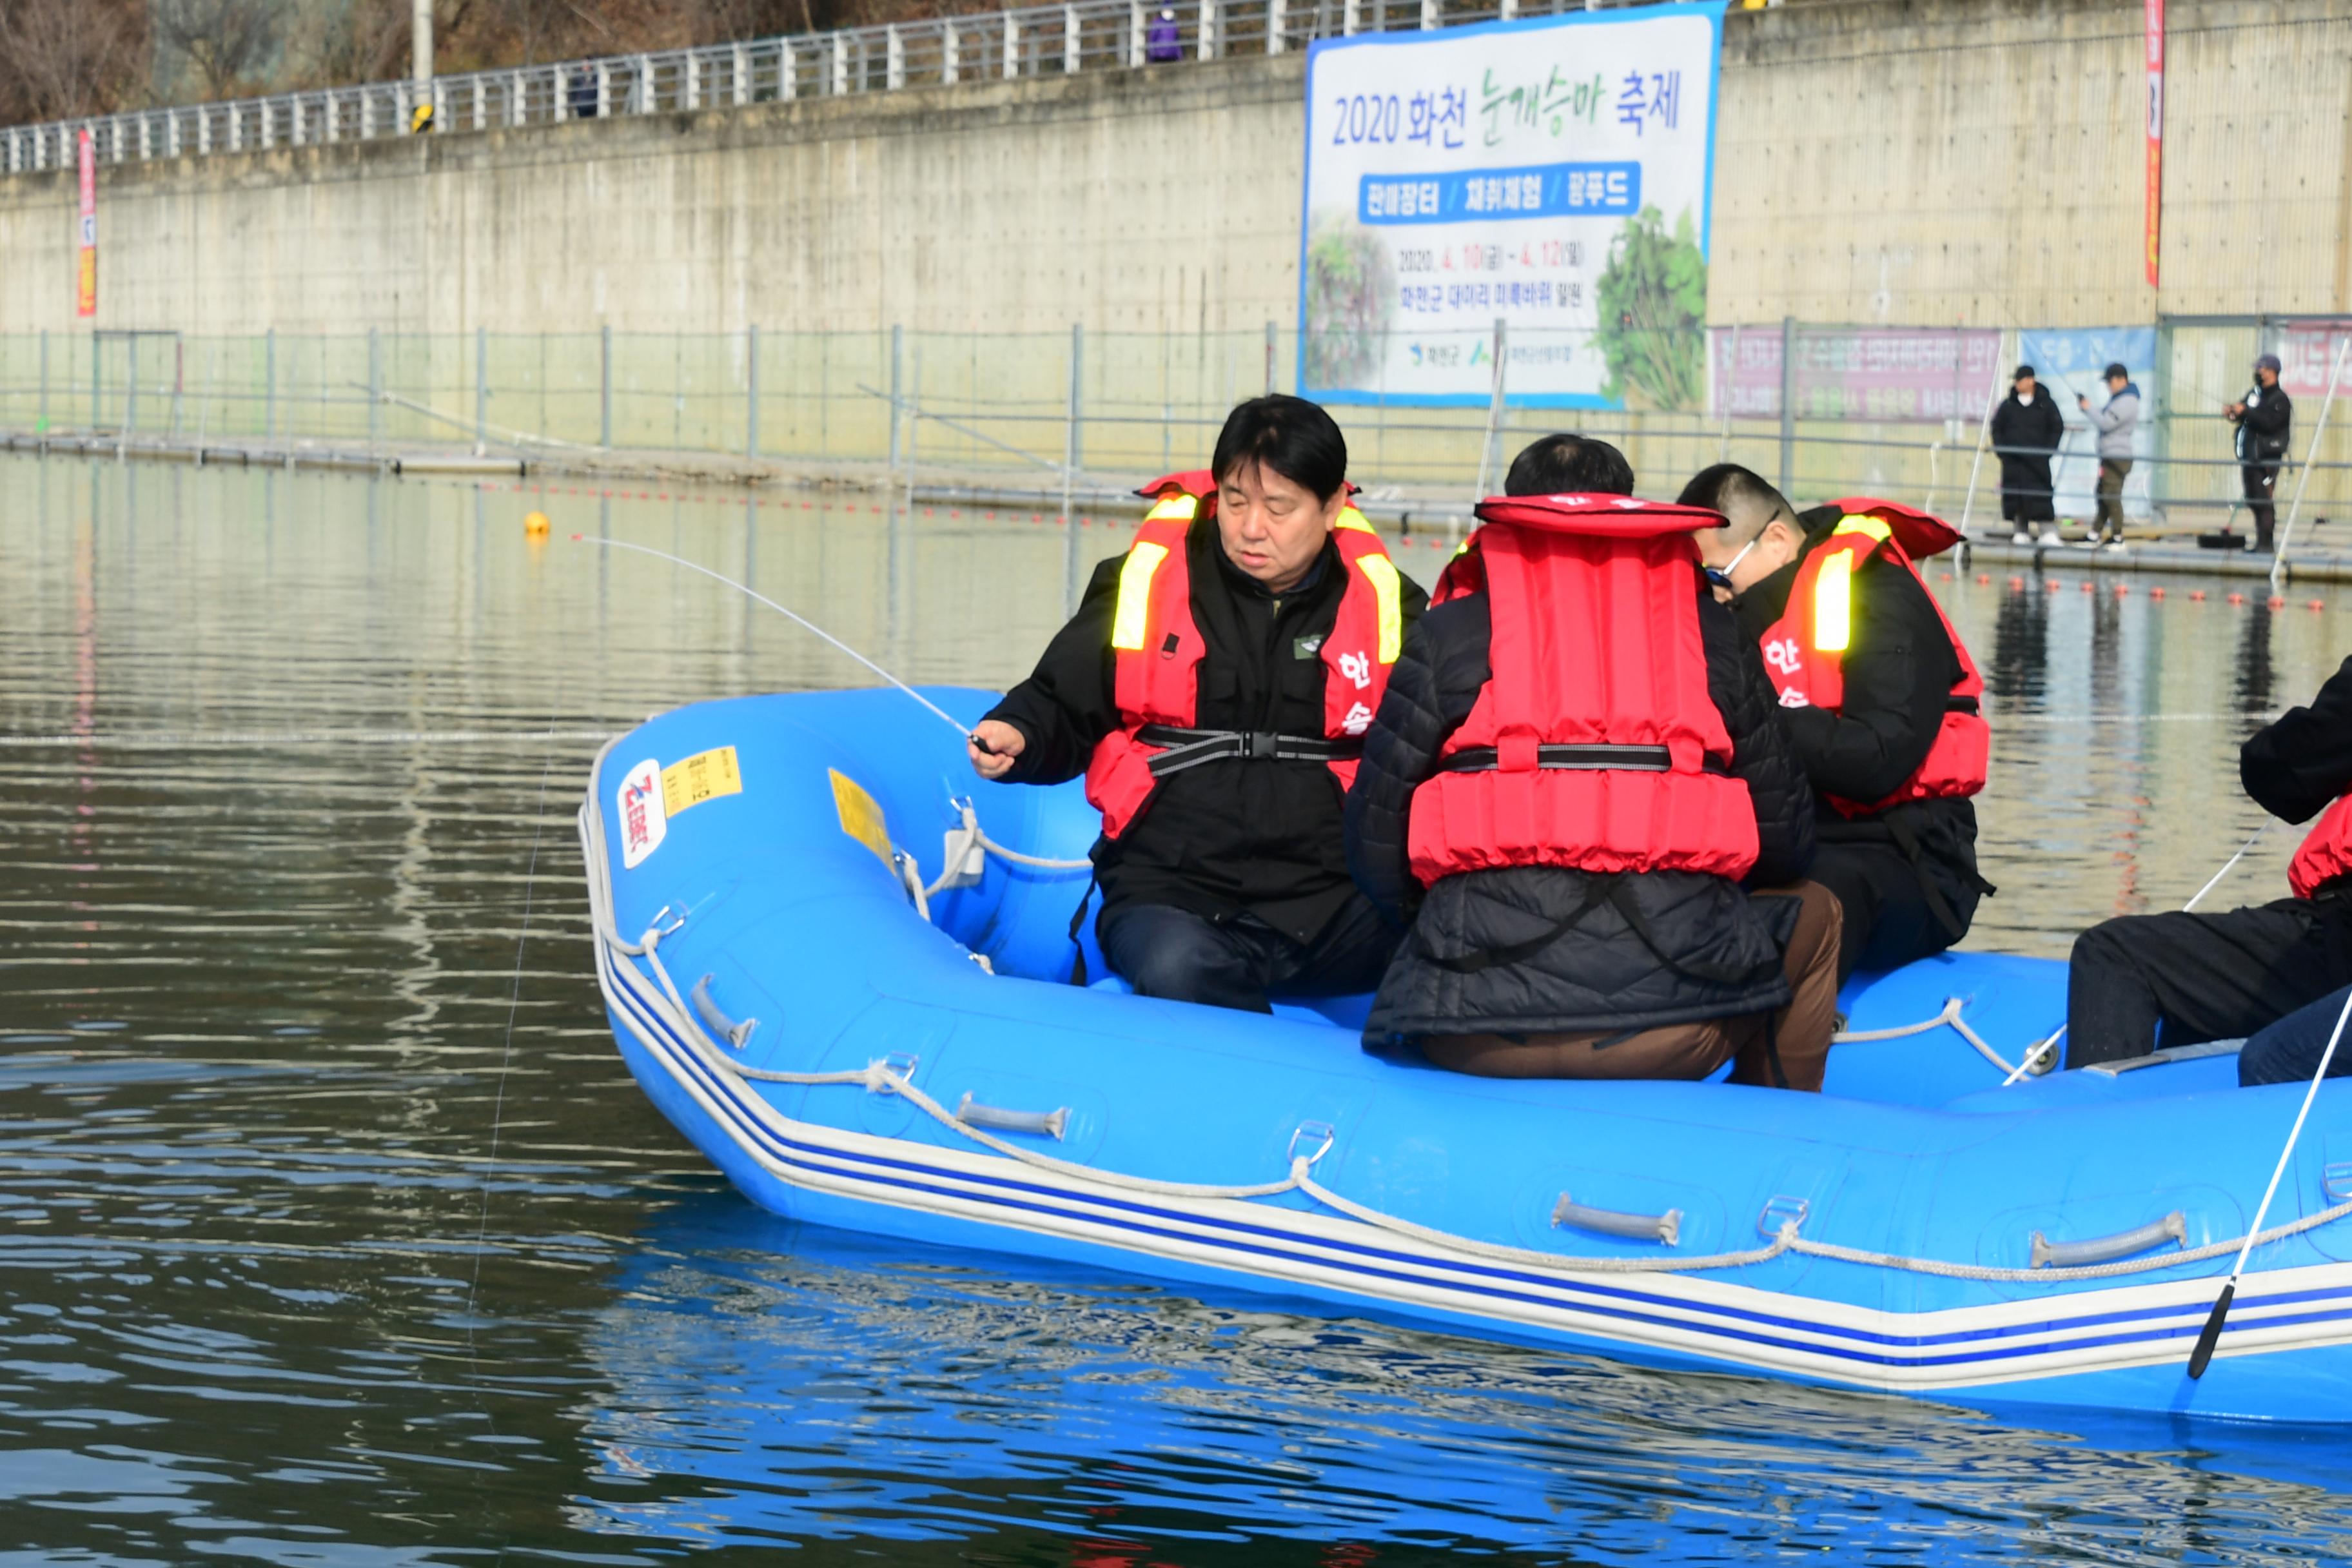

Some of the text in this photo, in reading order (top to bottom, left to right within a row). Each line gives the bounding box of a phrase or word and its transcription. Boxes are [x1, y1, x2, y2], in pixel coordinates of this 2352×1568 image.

[1333, 63, 1681, 149] 2020 화천 눈개승마 축제
[1367, 181, 1440, 216] 판매장터
